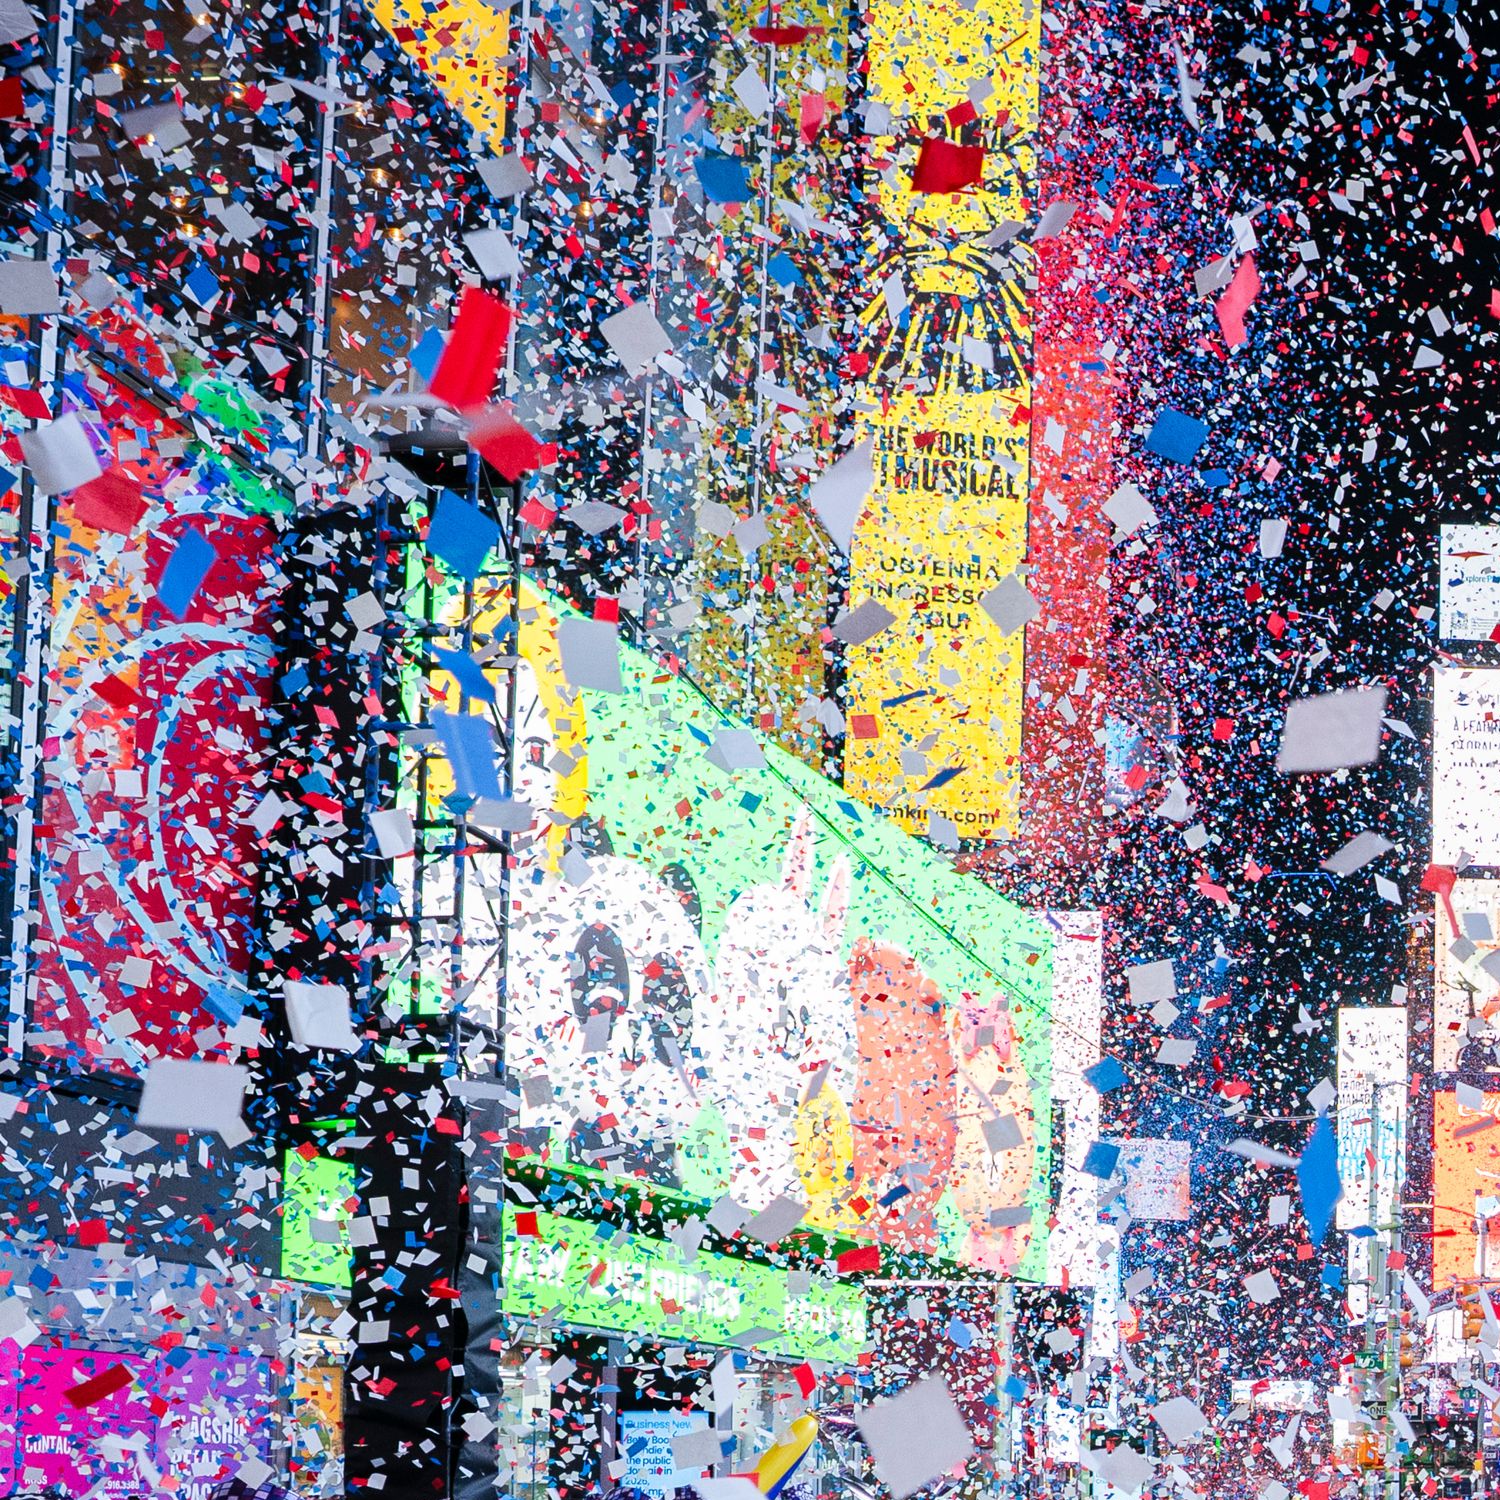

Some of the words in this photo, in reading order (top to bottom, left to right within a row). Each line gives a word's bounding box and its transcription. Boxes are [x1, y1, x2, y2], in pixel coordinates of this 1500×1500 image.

[895, 455, 1019, 499] MUSICAL
[880, 556, 1001, 580] OBTENHA
[25, 1435, 72, 1455] CONTAC
[652, 1436, 670, 1445] Boo
[643, 1457, 671, 1466] public
[627, 1467, 662, 1475] doai
